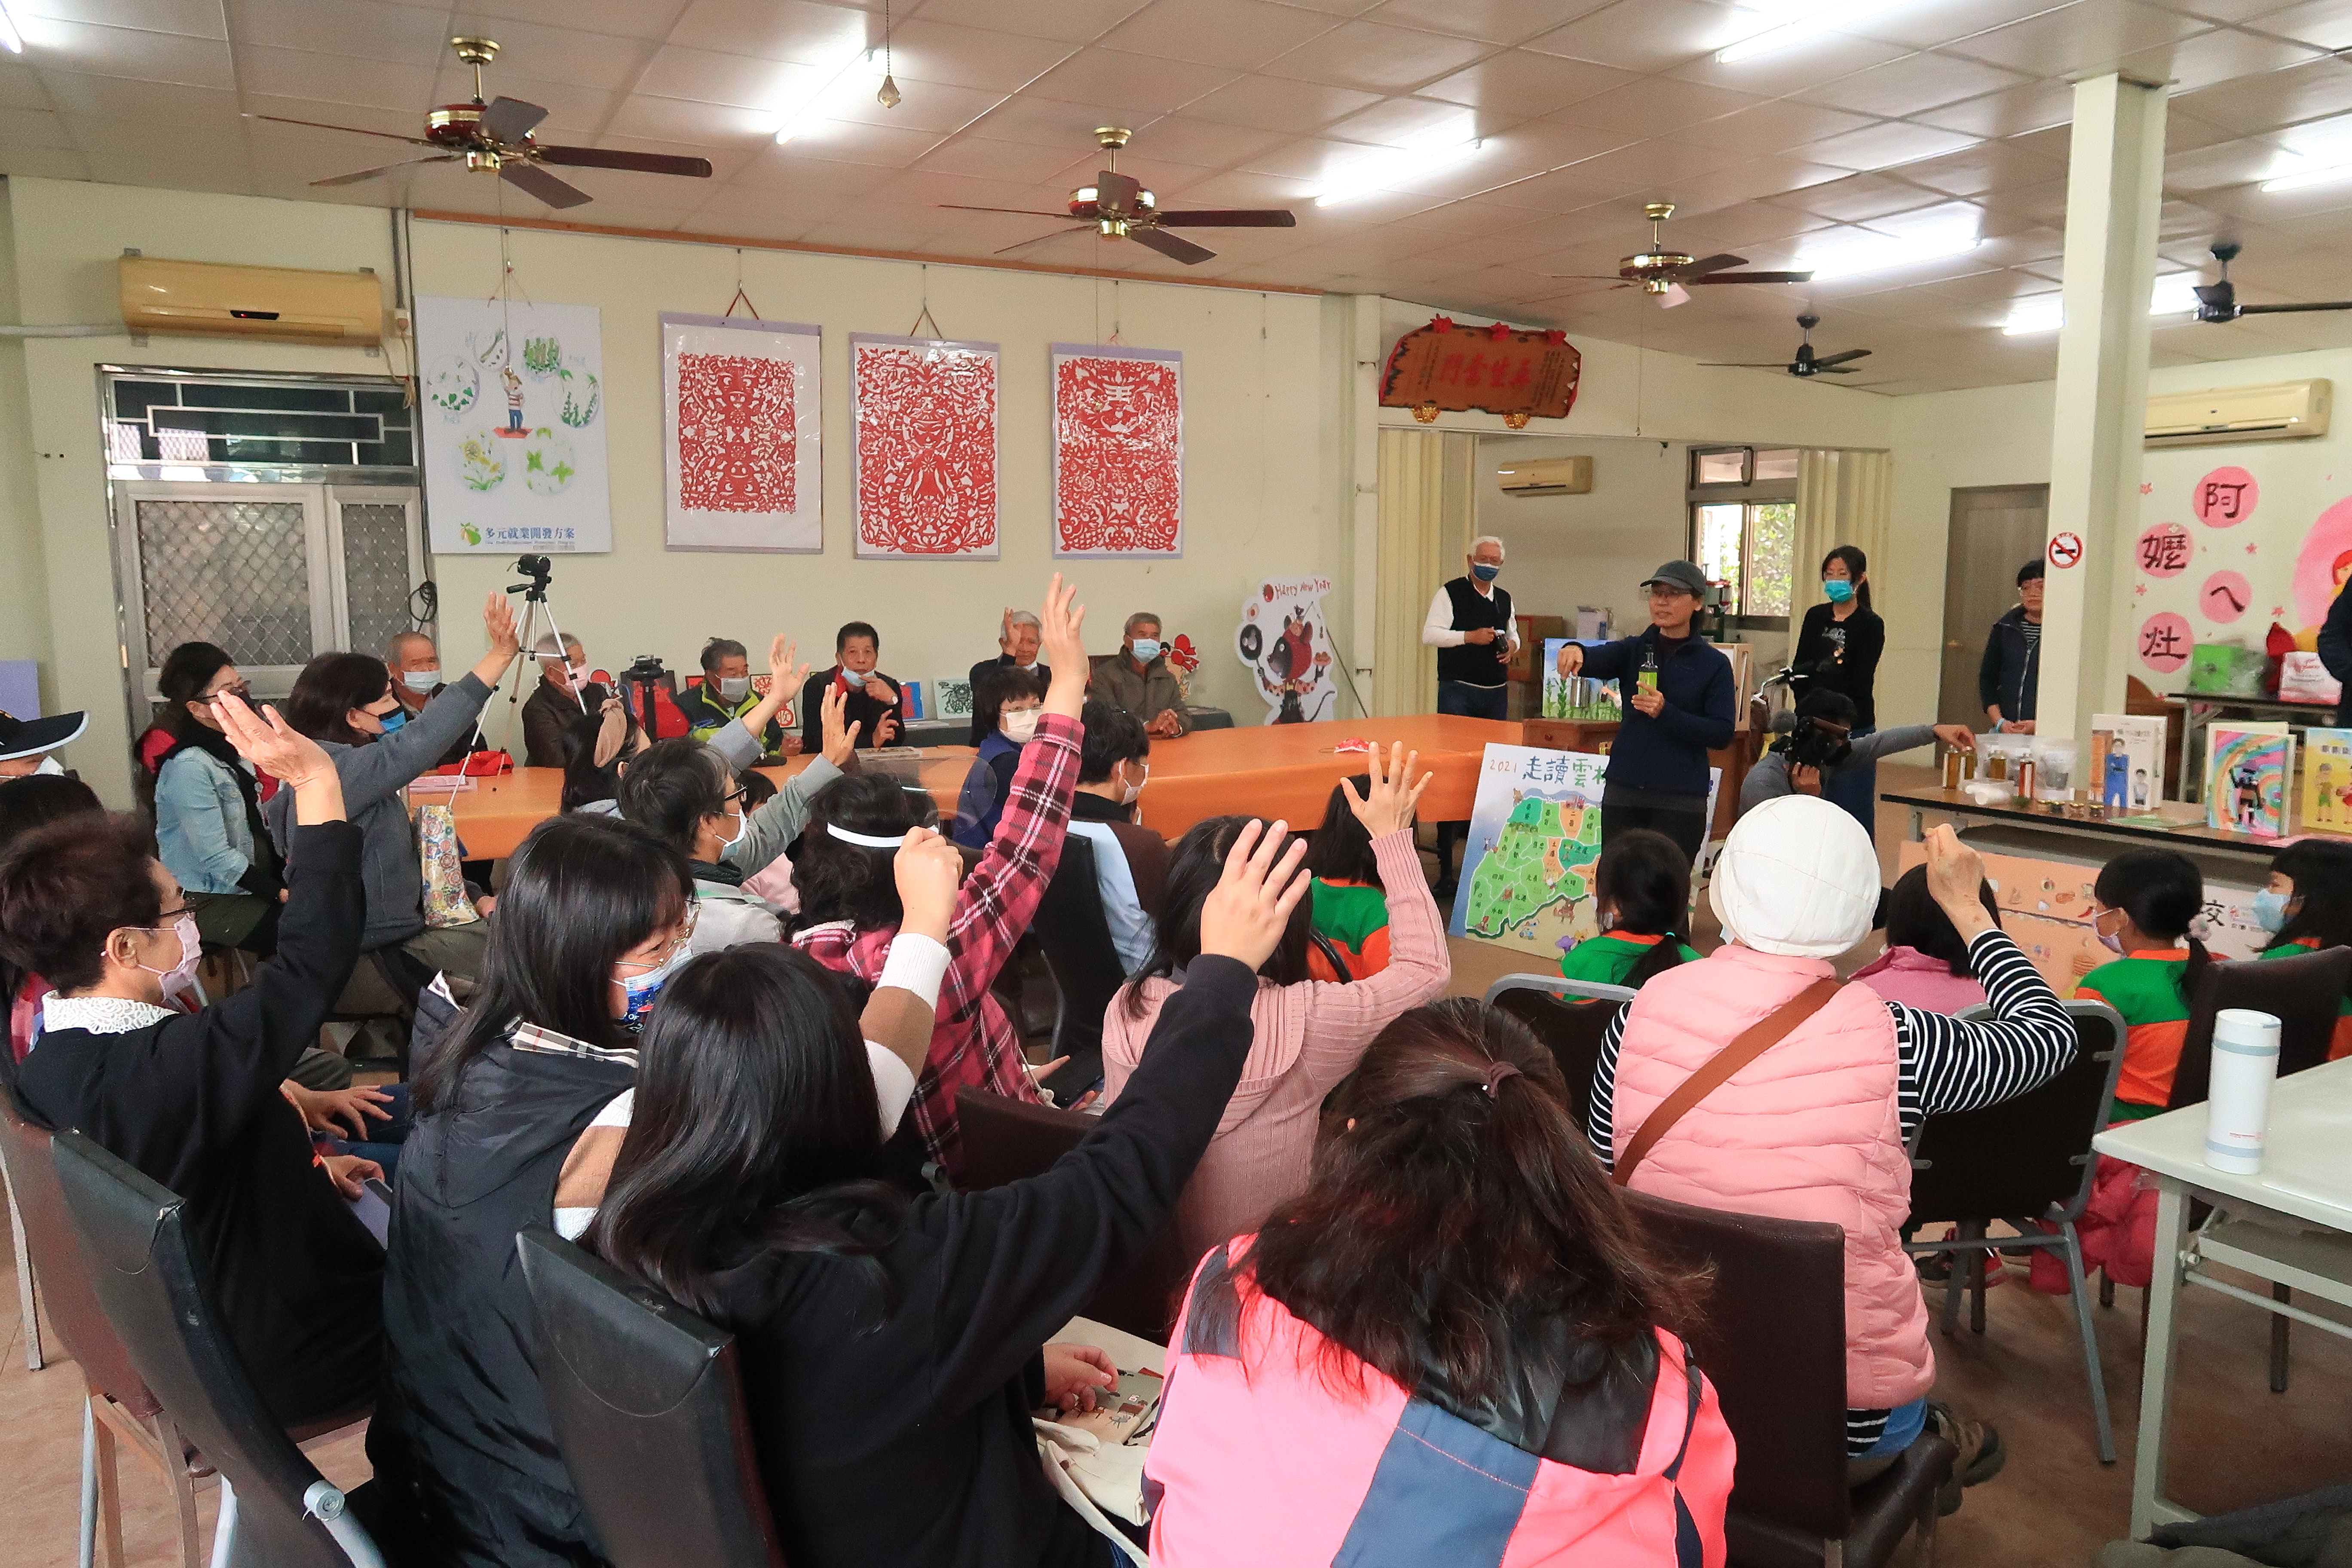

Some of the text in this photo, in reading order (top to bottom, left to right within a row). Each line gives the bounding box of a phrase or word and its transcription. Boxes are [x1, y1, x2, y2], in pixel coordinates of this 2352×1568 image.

[2204, 483, 2248, 518] 阿
[2142, 626, 2188, 660] 灶
[1489, 759, 1517, 772] 2021
